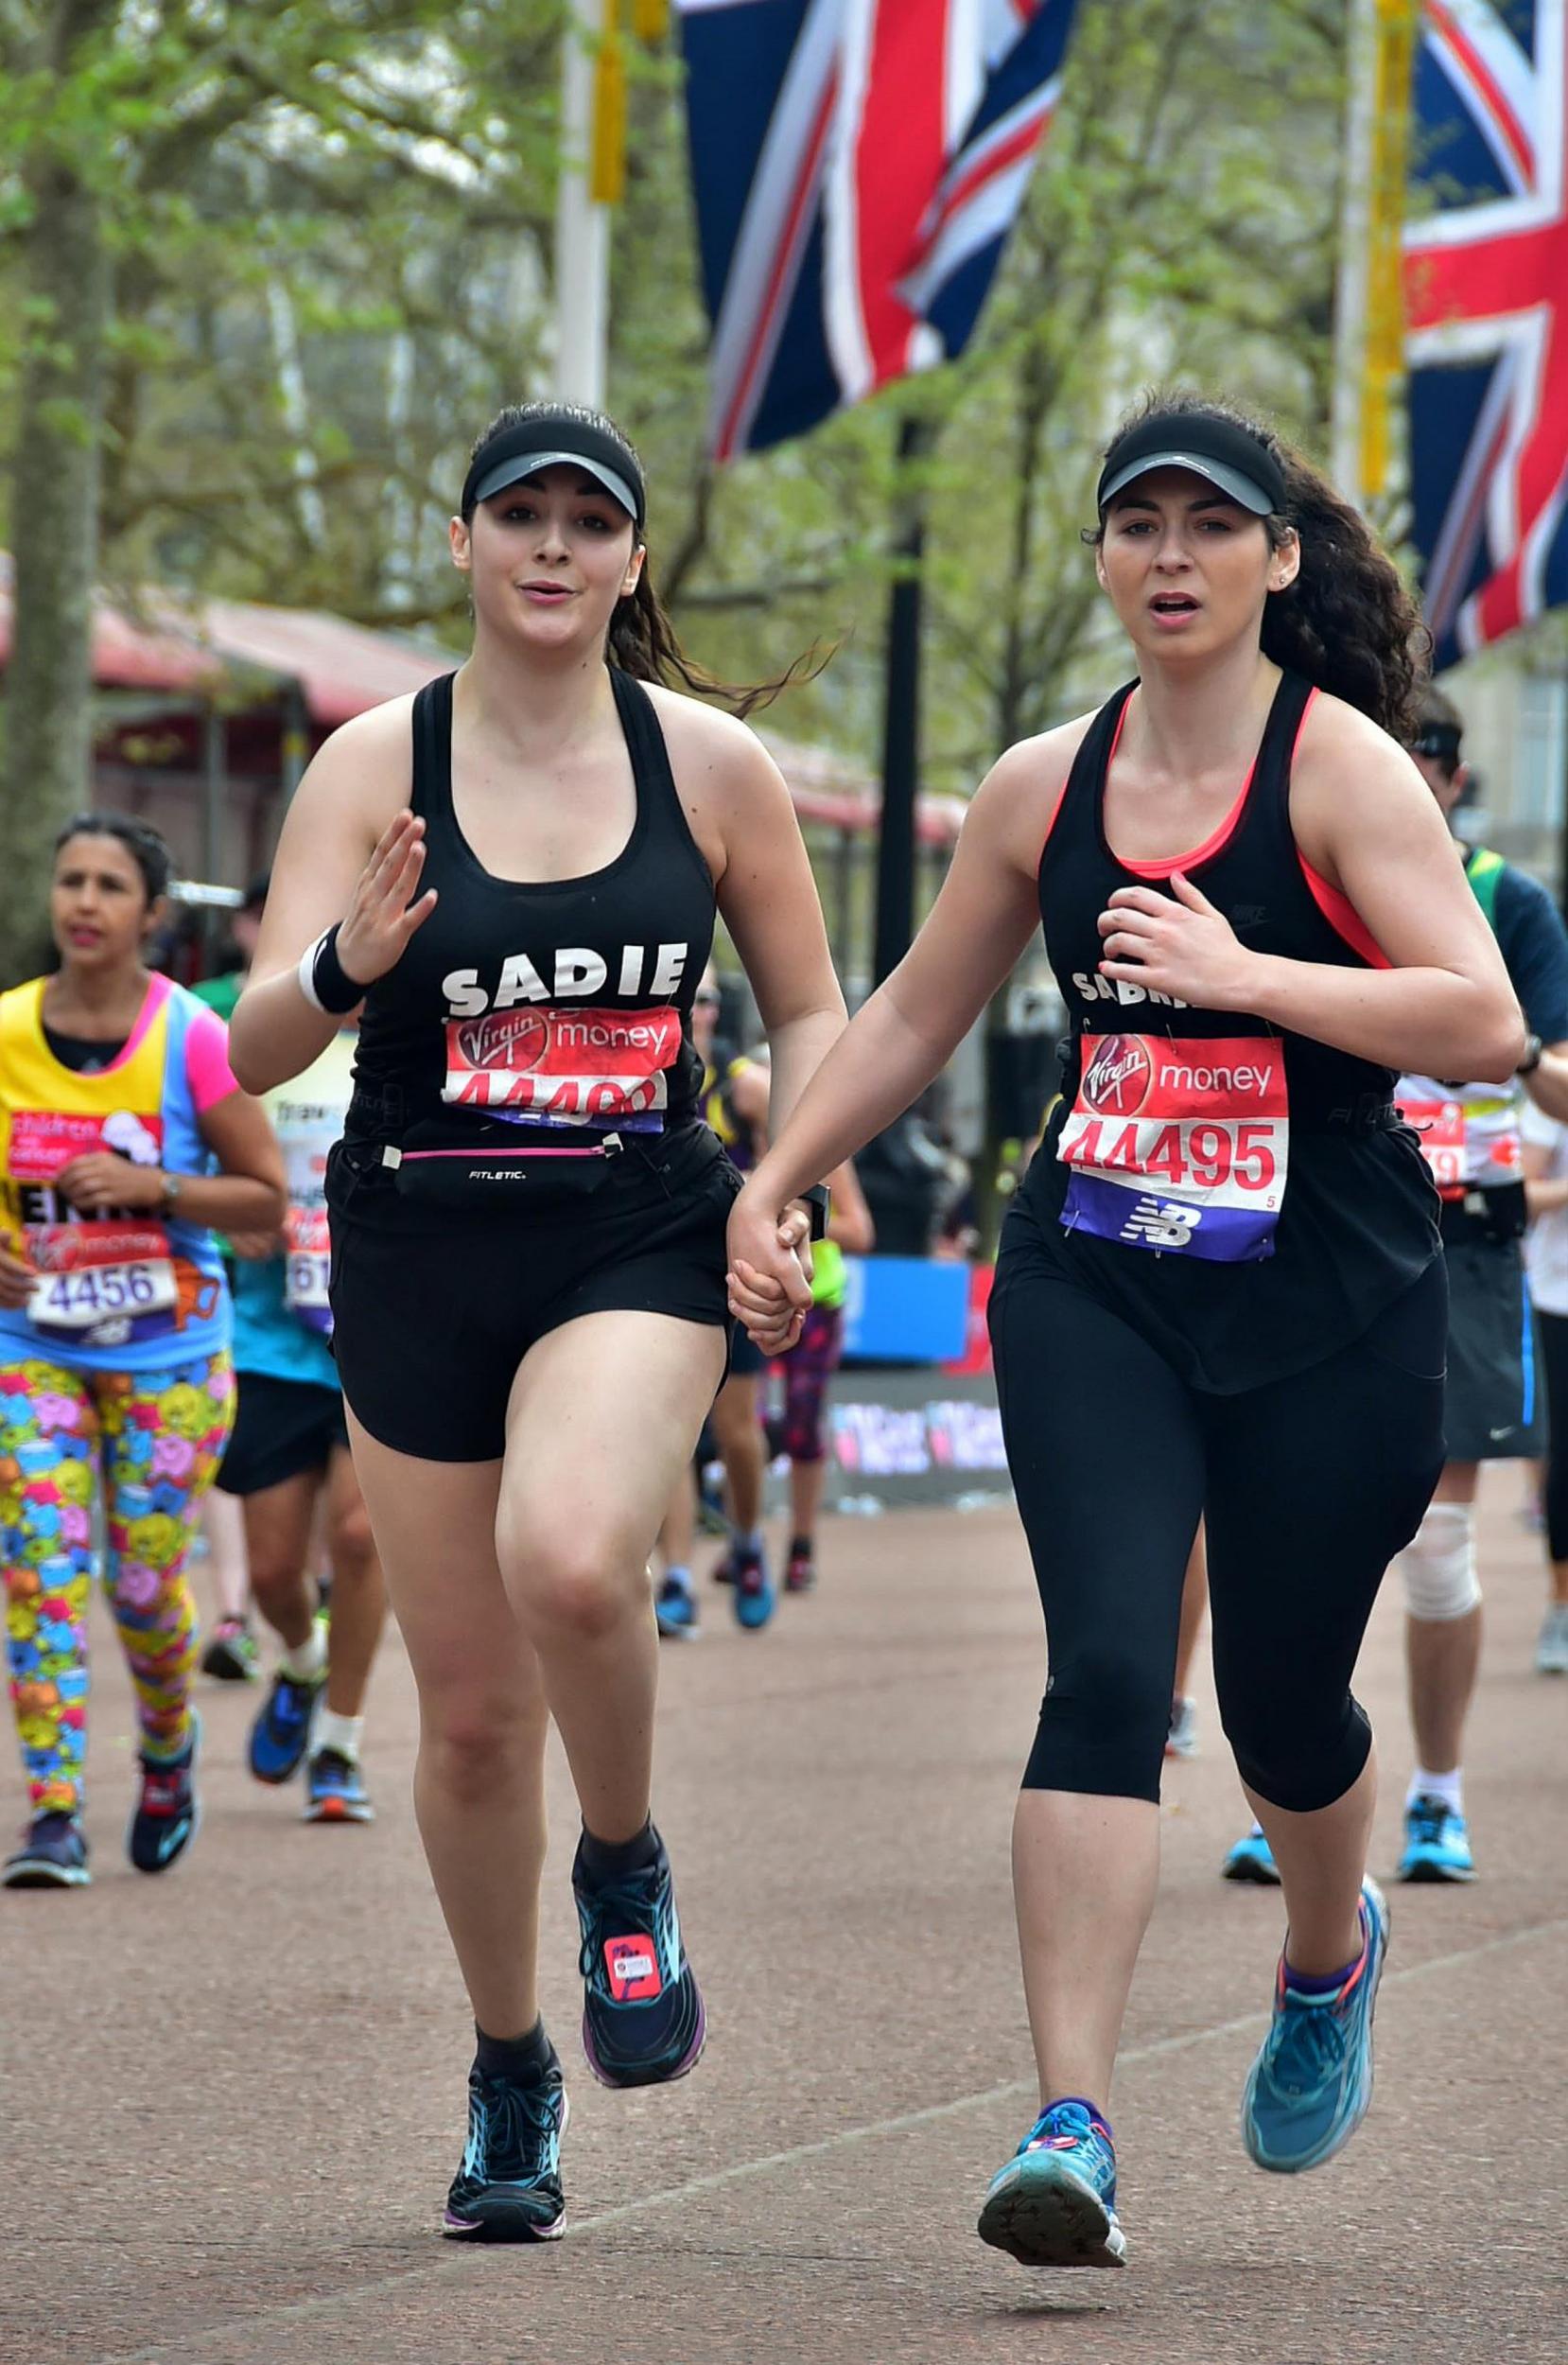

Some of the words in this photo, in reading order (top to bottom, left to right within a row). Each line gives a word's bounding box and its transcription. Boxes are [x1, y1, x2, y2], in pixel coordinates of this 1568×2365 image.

[442, 942, 688, 1017] SADIE
[463, 1015, 544, 1065] Virgin
[556, 1022, 668, 1055] money
[1088, 1037, 1148, 1109] Virgin
[1159, 1063, 1272, 1097] money
[468, 1169, 522, 1181] FITLETIC
[1063, 1120, 1276, 1191] 44495
[1265, 1195, 1276, 1209] 5
[48, 1265, 154, 1311] 4456
